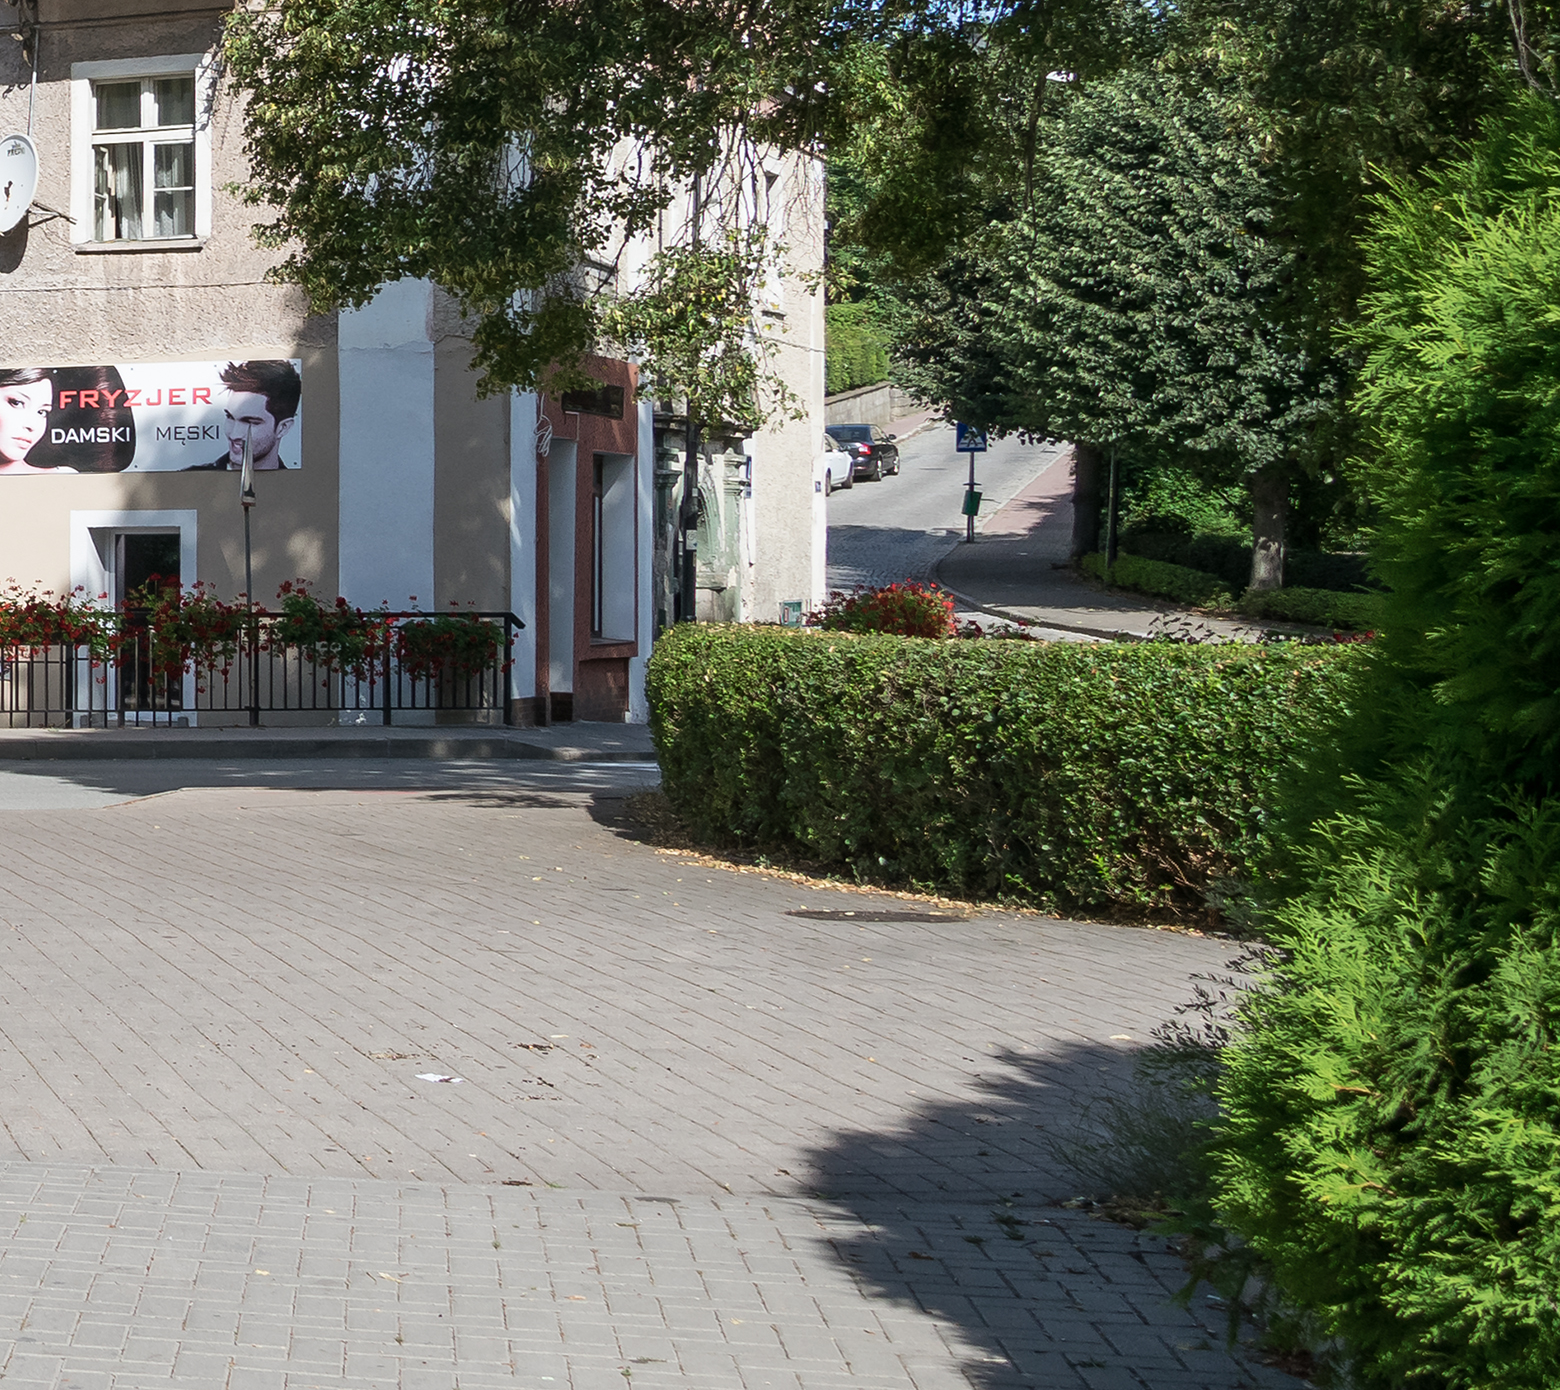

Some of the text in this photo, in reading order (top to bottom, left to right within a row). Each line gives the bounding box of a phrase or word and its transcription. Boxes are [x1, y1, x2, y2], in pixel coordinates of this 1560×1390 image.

[59, 387, 213, 409] FRYZJER
[51, 425, 220, 446] DAMSKI MĘSKI
